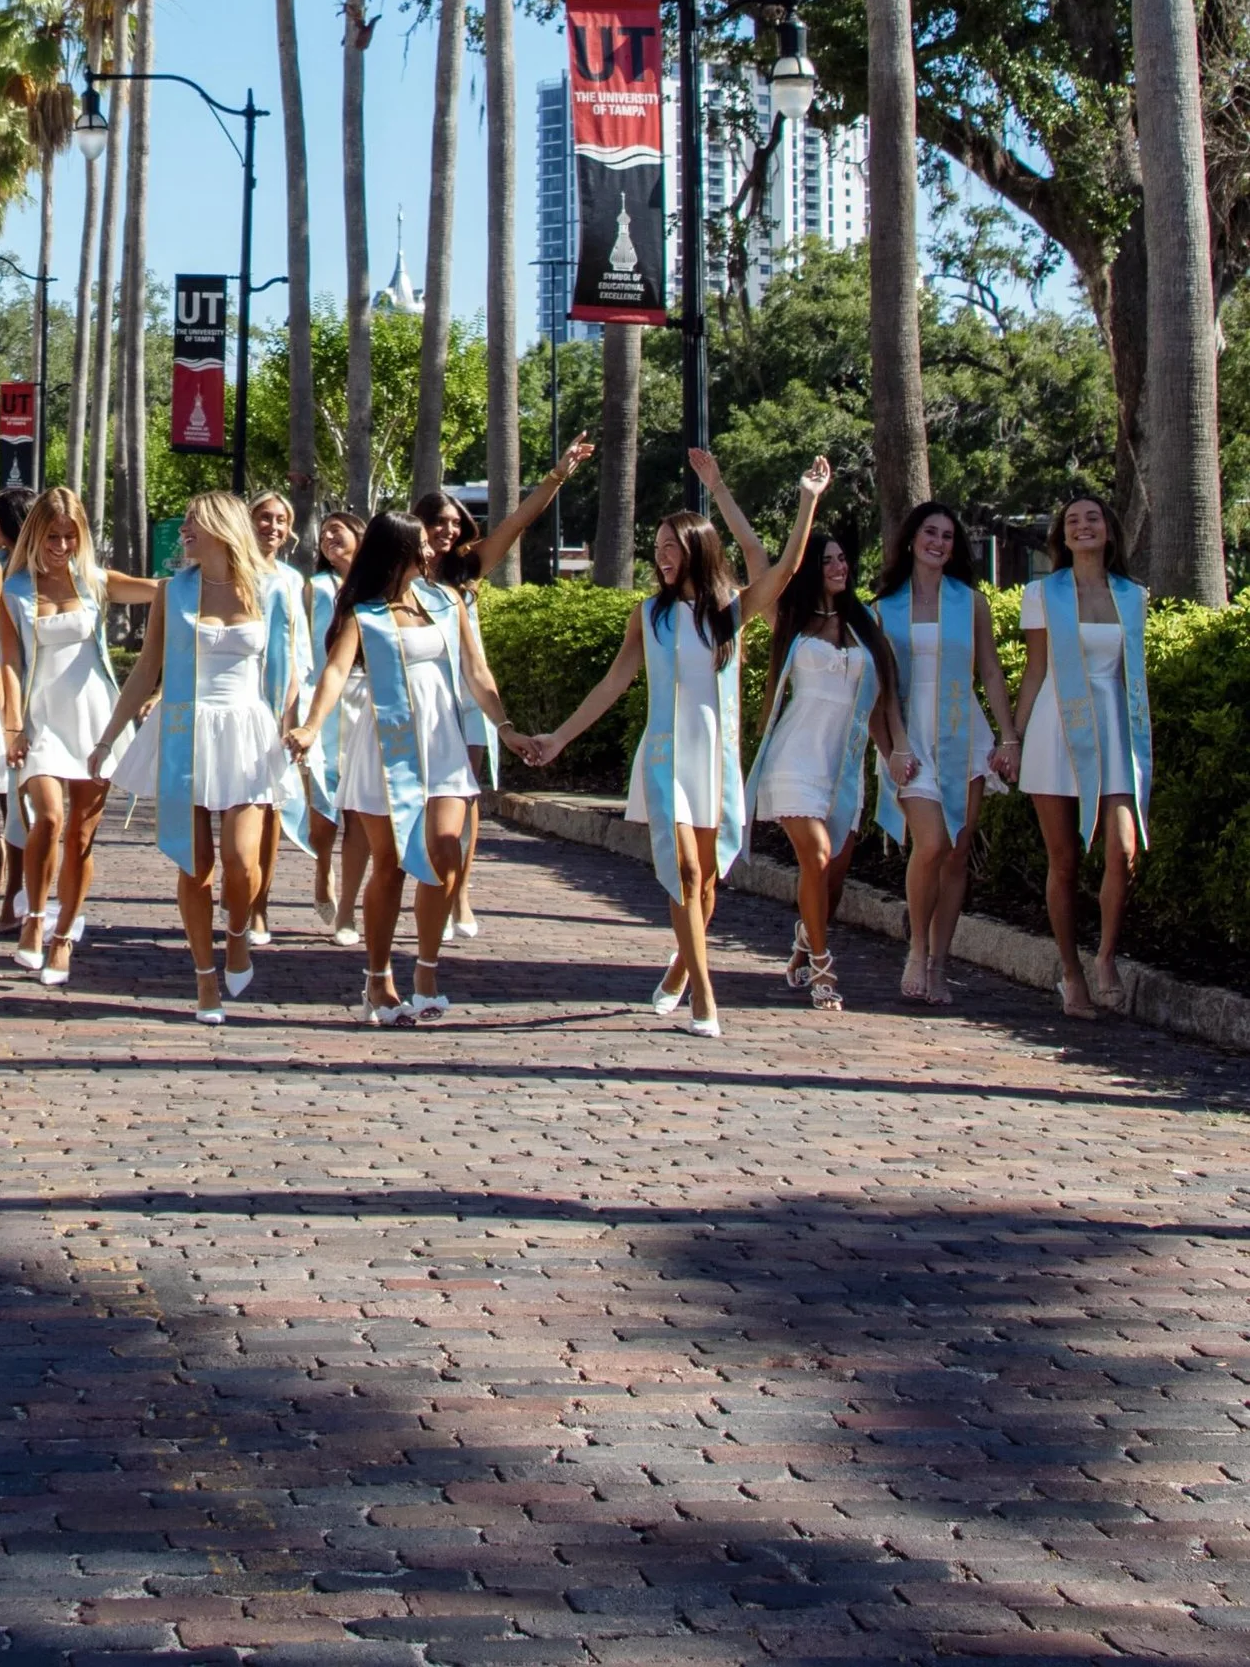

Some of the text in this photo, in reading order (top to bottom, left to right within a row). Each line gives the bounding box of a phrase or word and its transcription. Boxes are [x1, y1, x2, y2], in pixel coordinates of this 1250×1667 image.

[573, 26, 656, 82] UT
[574, 91, 659, 105] THE UNIVERSITY
[593, 104, 646, 117] OF TAMPA
[603, 272, 642, 282] SYMBOL OF
[598, 281, 645, 292] EDUCATIONAL
[599, 291, 642, 301] EXCELLENCE
[178, 291, 224, 325] UT
[2, 393, 31, 414] UT
